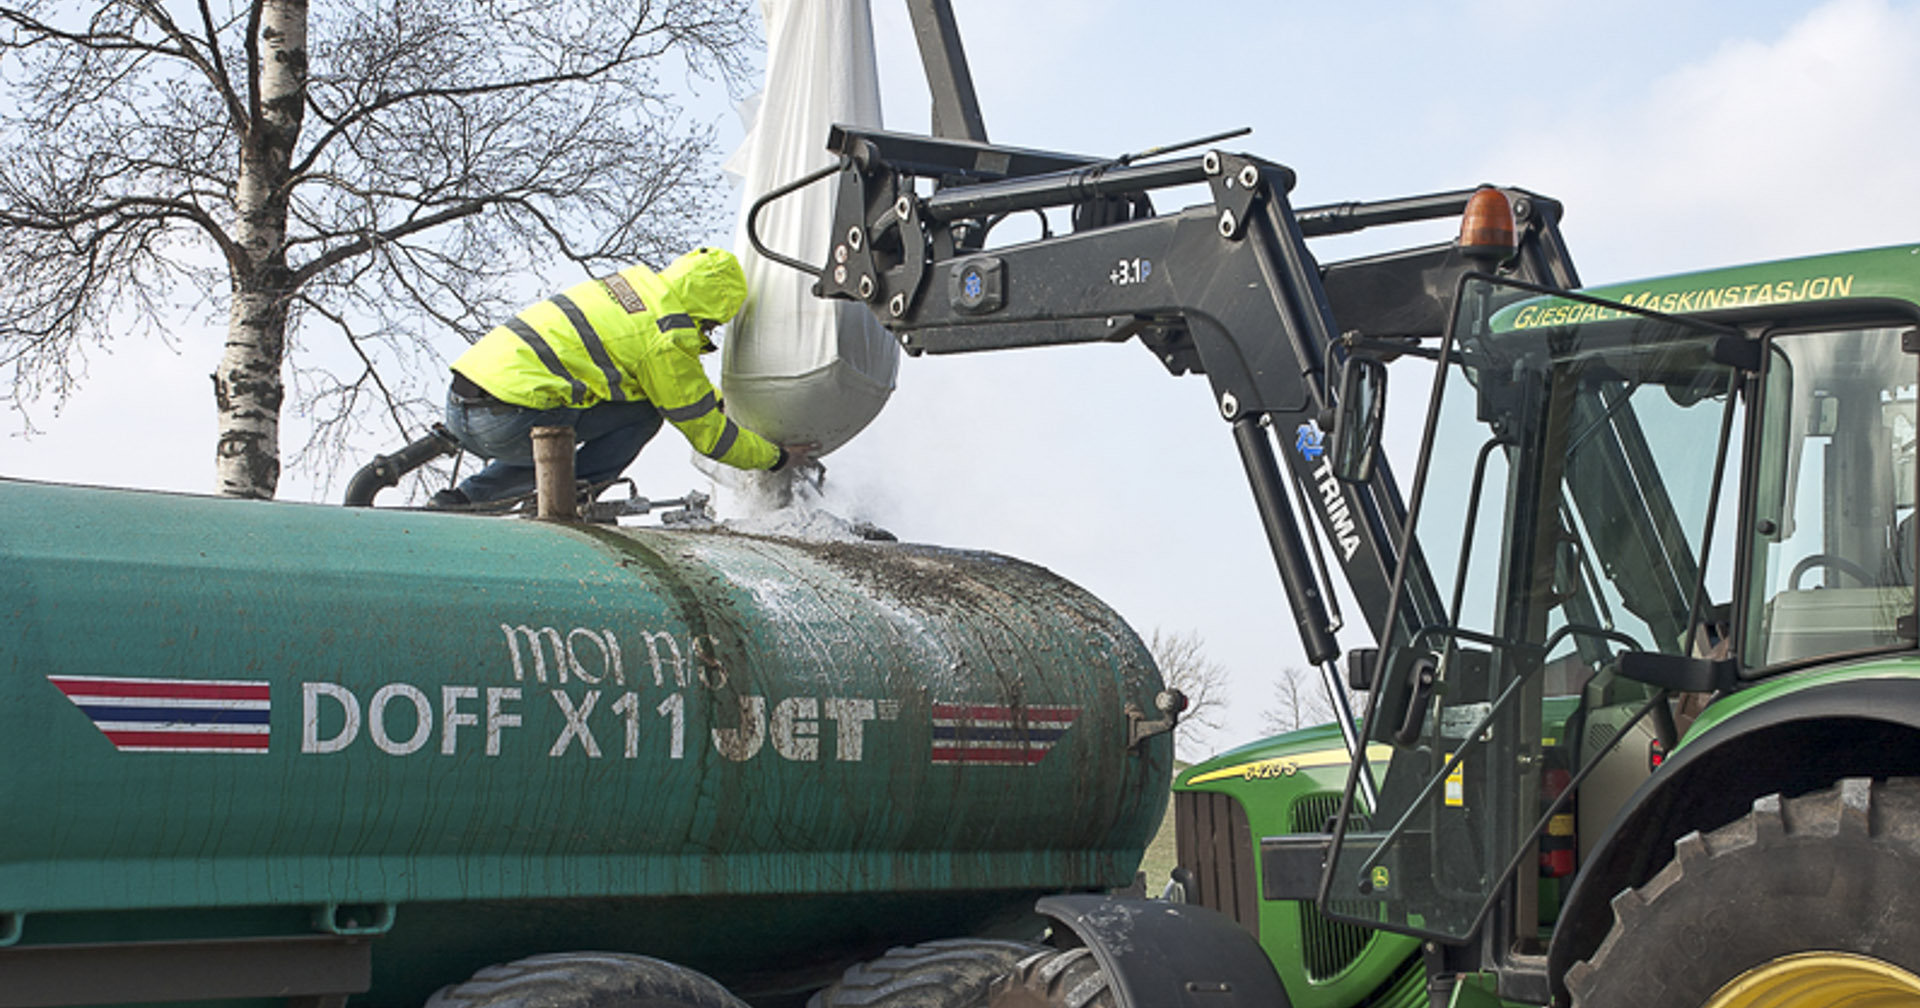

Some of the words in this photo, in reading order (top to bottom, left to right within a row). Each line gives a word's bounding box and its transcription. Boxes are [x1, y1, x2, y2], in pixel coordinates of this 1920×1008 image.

[1312, 455, 1361, 562] TRIMA
[301, 682, 522, 756] DOFF
[548, 690, 684, 759] X11
[711, 695, 876, 761] JET
